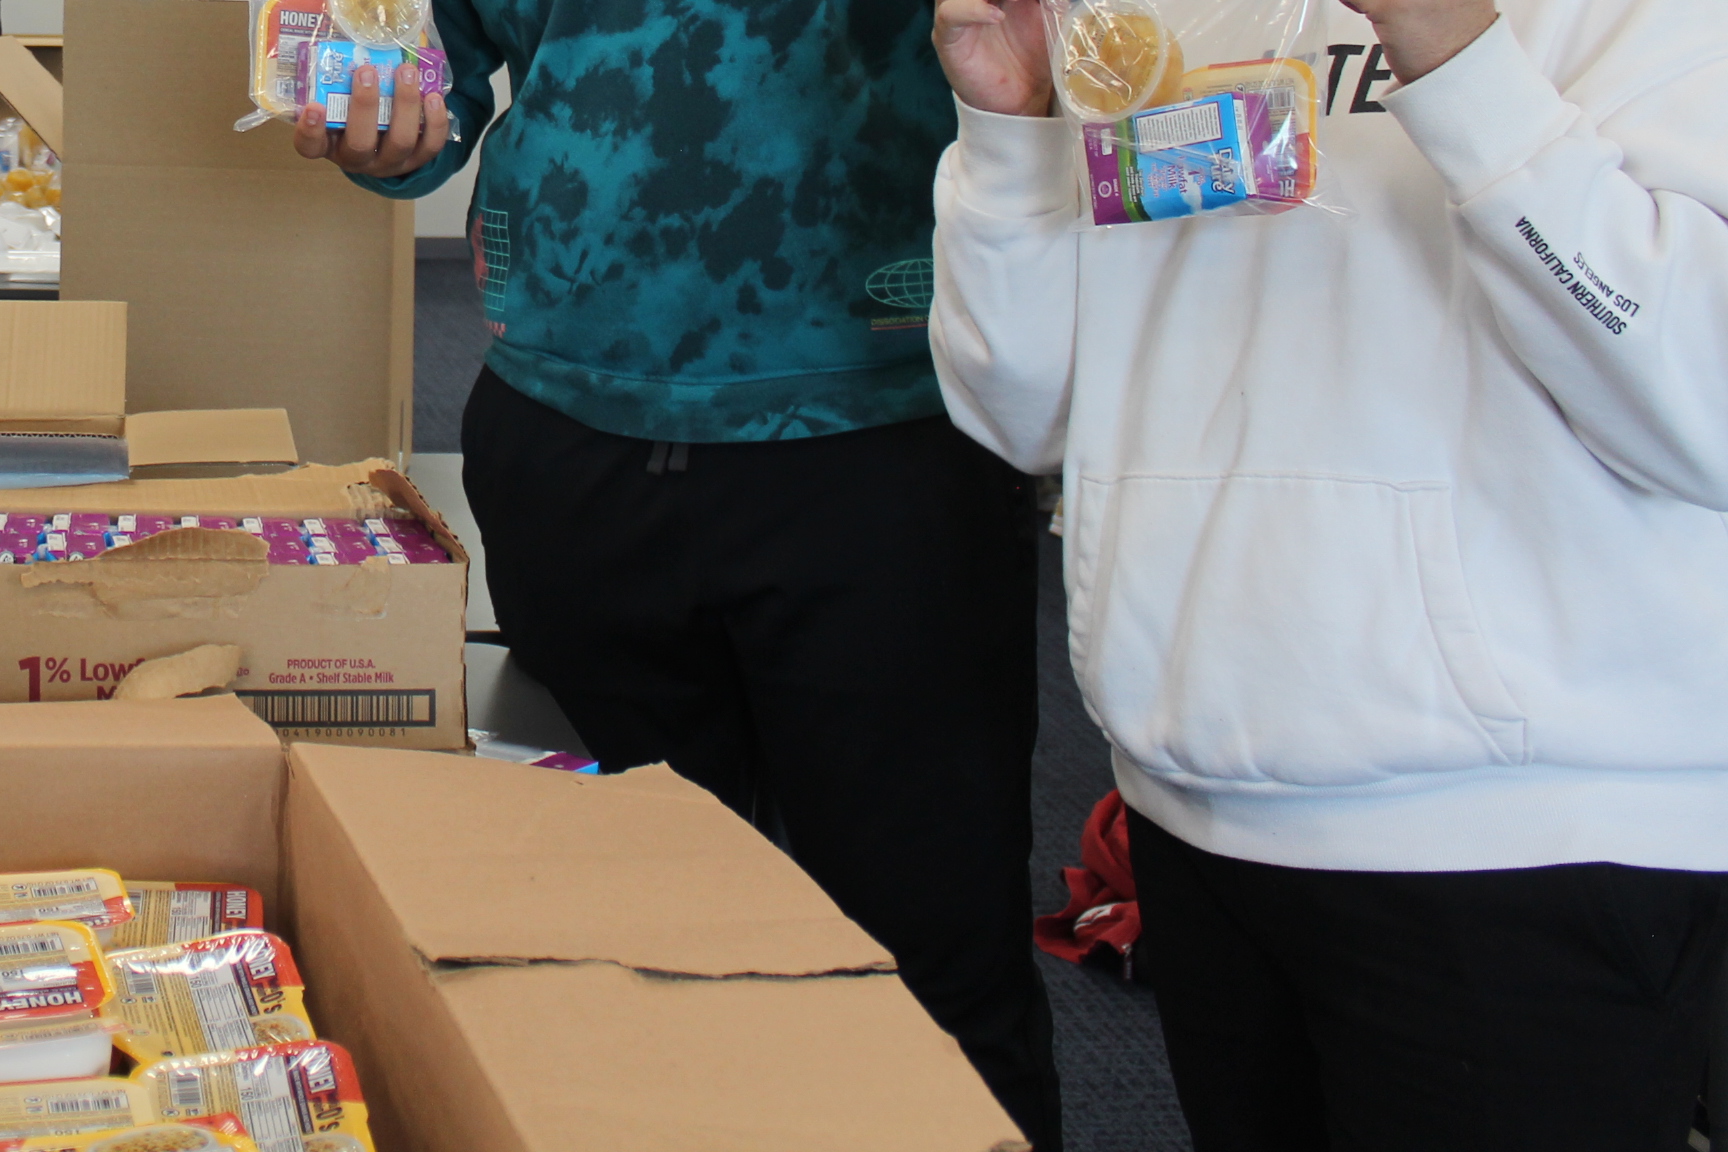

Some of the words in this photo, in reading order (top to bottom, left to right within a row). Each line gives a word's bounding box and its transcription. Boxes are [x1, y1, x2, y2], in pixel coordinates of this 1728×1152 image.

[280, 10, 324, 28] HONEY
[1515, 216, 1574, 284] CALIFORNIA
[1573, 251, 1614, 298] ANGELES
[1567, 280, 1627, 335] SOUTHERN
[1613, 294, 1640, 318] LOS
[287, 659, 333, 669] PRODUCT
[335, 659, 348, 669] OF
[350, 659, 376, 669] U.S.A.
[18, 656, 71, 702] 1%
[269, 673, 298, 684] Grade
[300, 673, 306, 684] A
[316, 673, 340, 684] Shelf
[342, 673, 372, 684] Stable
[375, 673, 394, 684] Milk
[226, 890, 247, 919] HONEY
[189, 975, 202, 989] 150
[240, 1087, 253, 1100] 150
